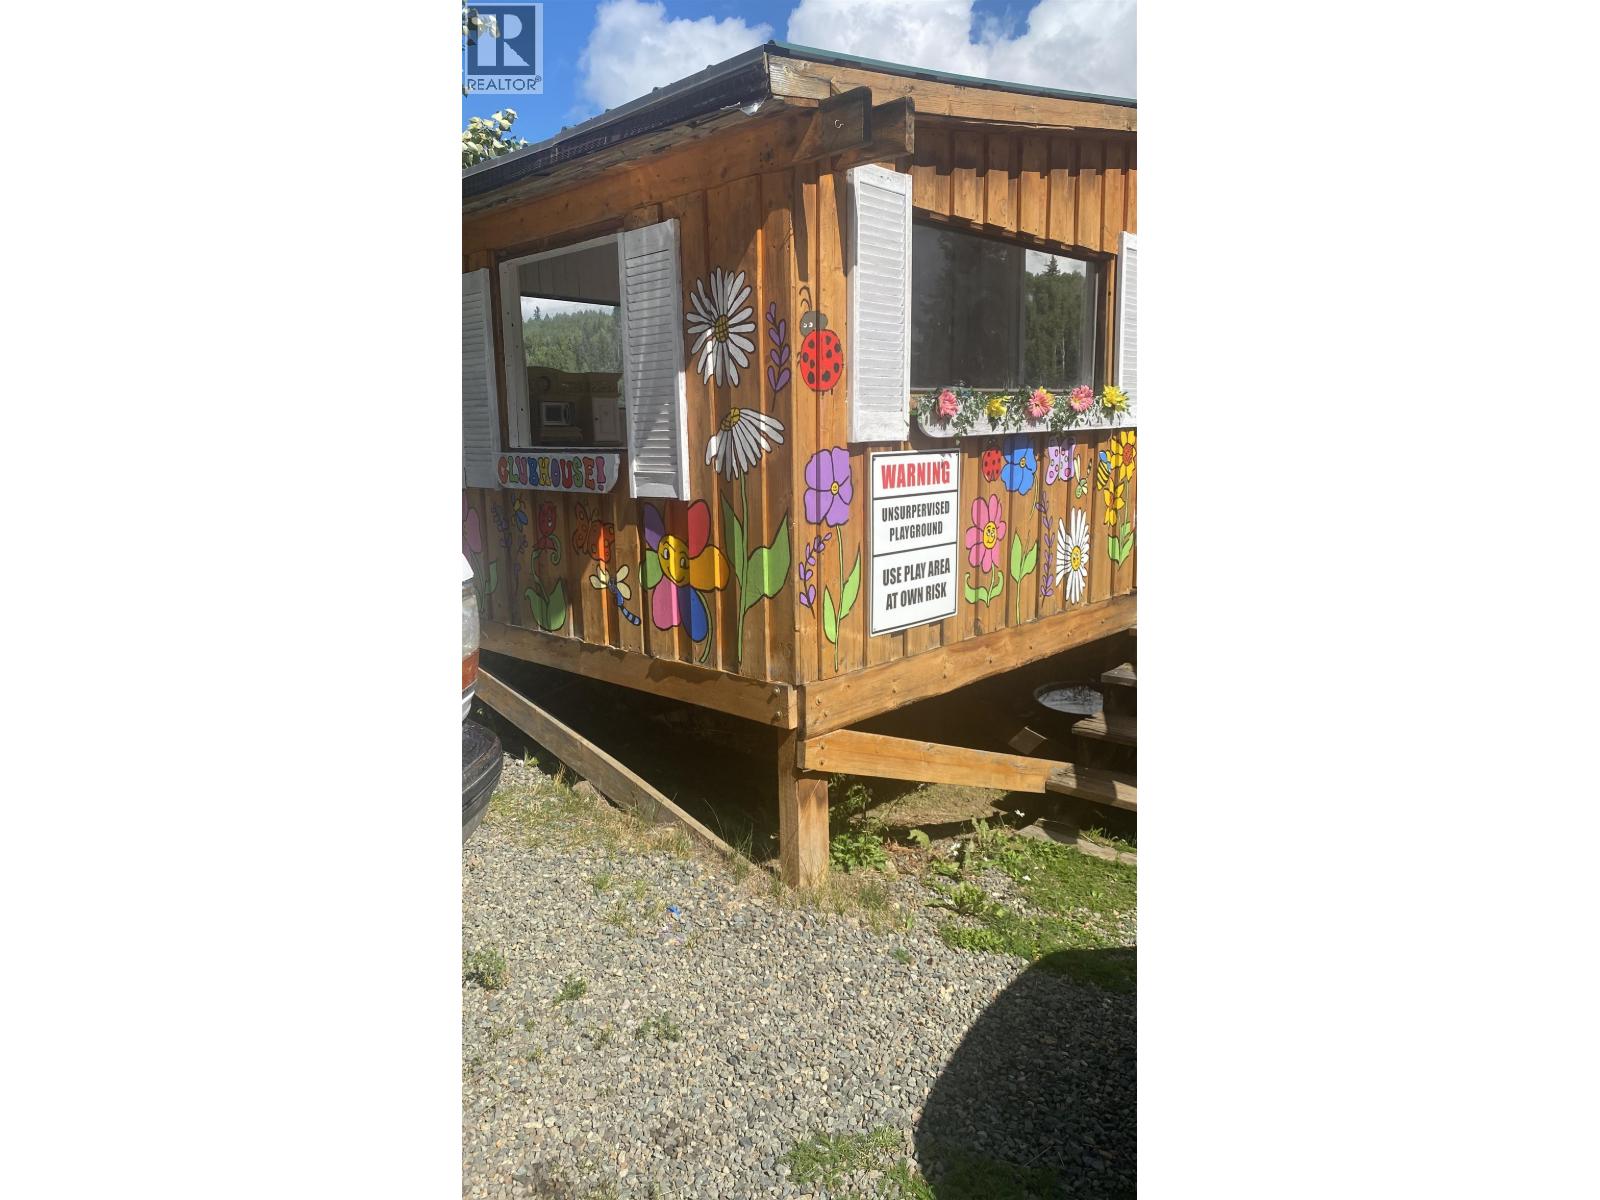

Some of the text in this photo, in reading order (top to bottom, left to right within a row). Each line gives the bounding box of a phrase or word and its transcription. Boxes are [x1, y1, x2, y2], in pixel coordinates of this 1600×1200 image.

[497, 455, 607, 491] CLUBHOUSE!
[881, 460, 951, 490] WARNING
[881, 500, 950, 523] UNSURPERVISED
[889, 520, 943, 542] PLAYGROUND
[882, 557, 951, 587] USE PLAY AREA
[885, 581, 947, 611] AT OWN RISK
